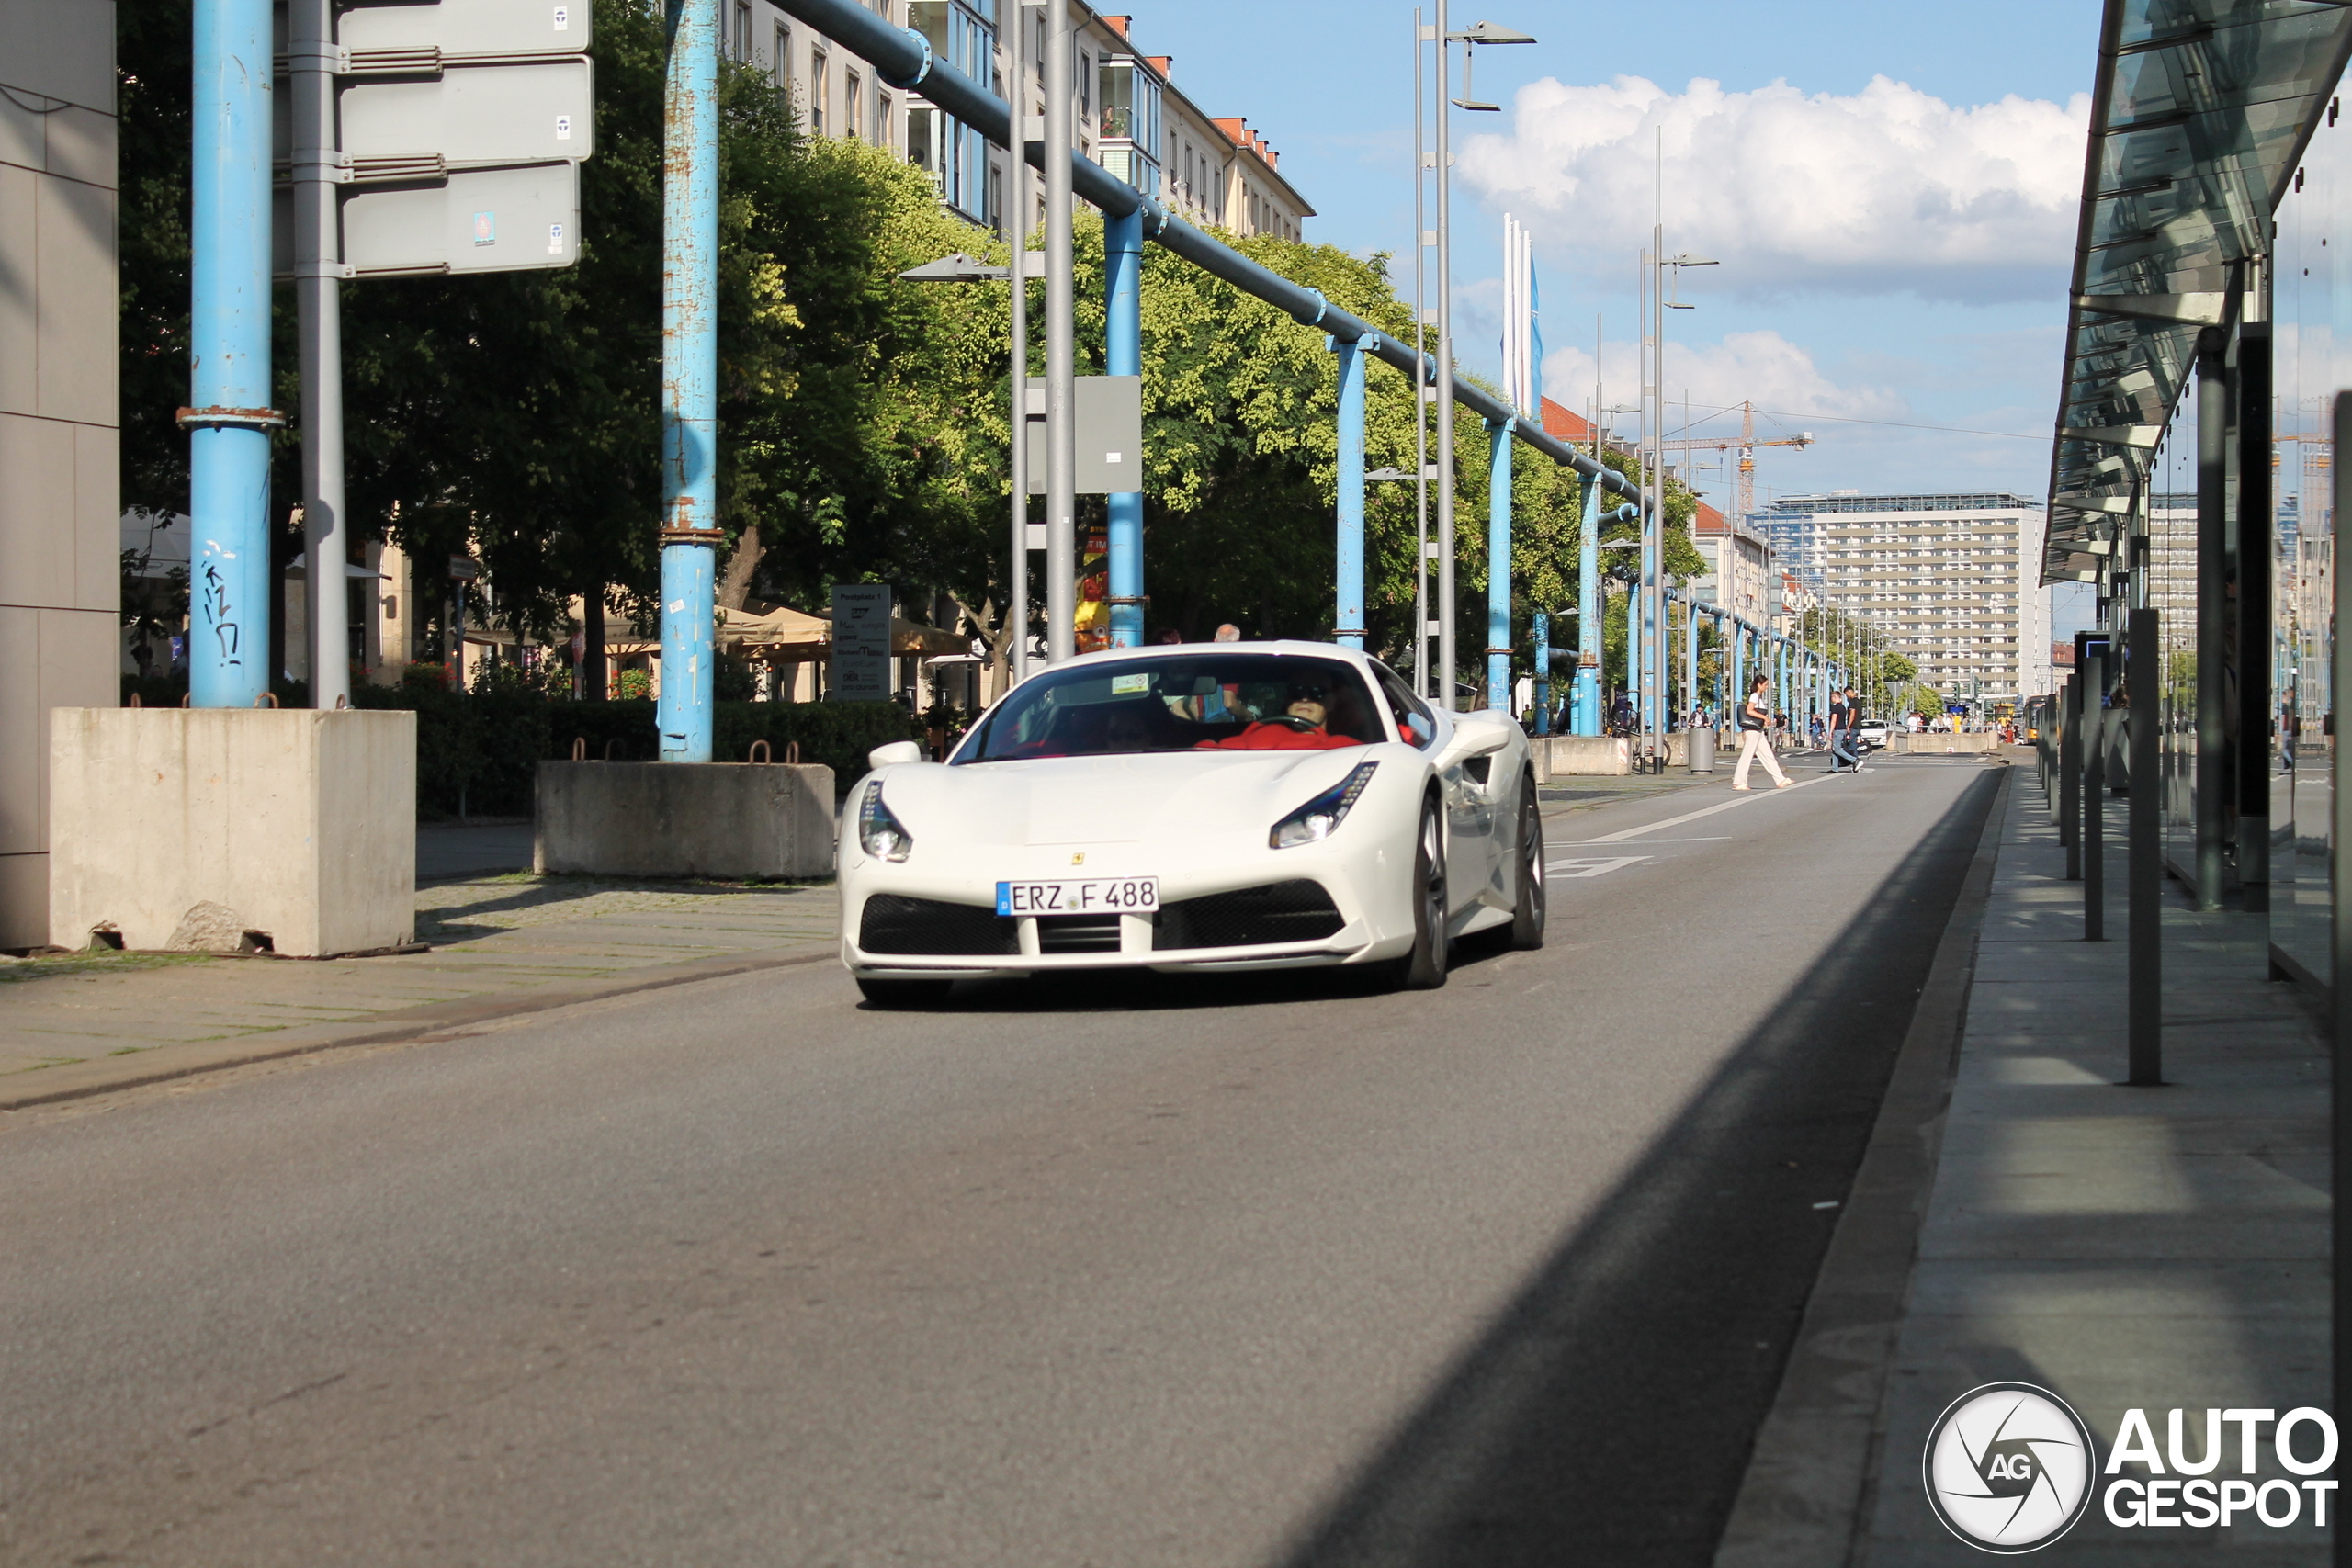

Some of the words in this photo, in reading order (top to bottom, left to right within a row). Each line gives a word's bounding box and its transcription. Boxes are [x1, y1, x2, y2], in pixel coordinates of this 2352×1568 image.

[1012, 885, 1063, 910] ERZ
[1081, 884, 1097, 908] F
[1105, 881, 1155, 908] 488
